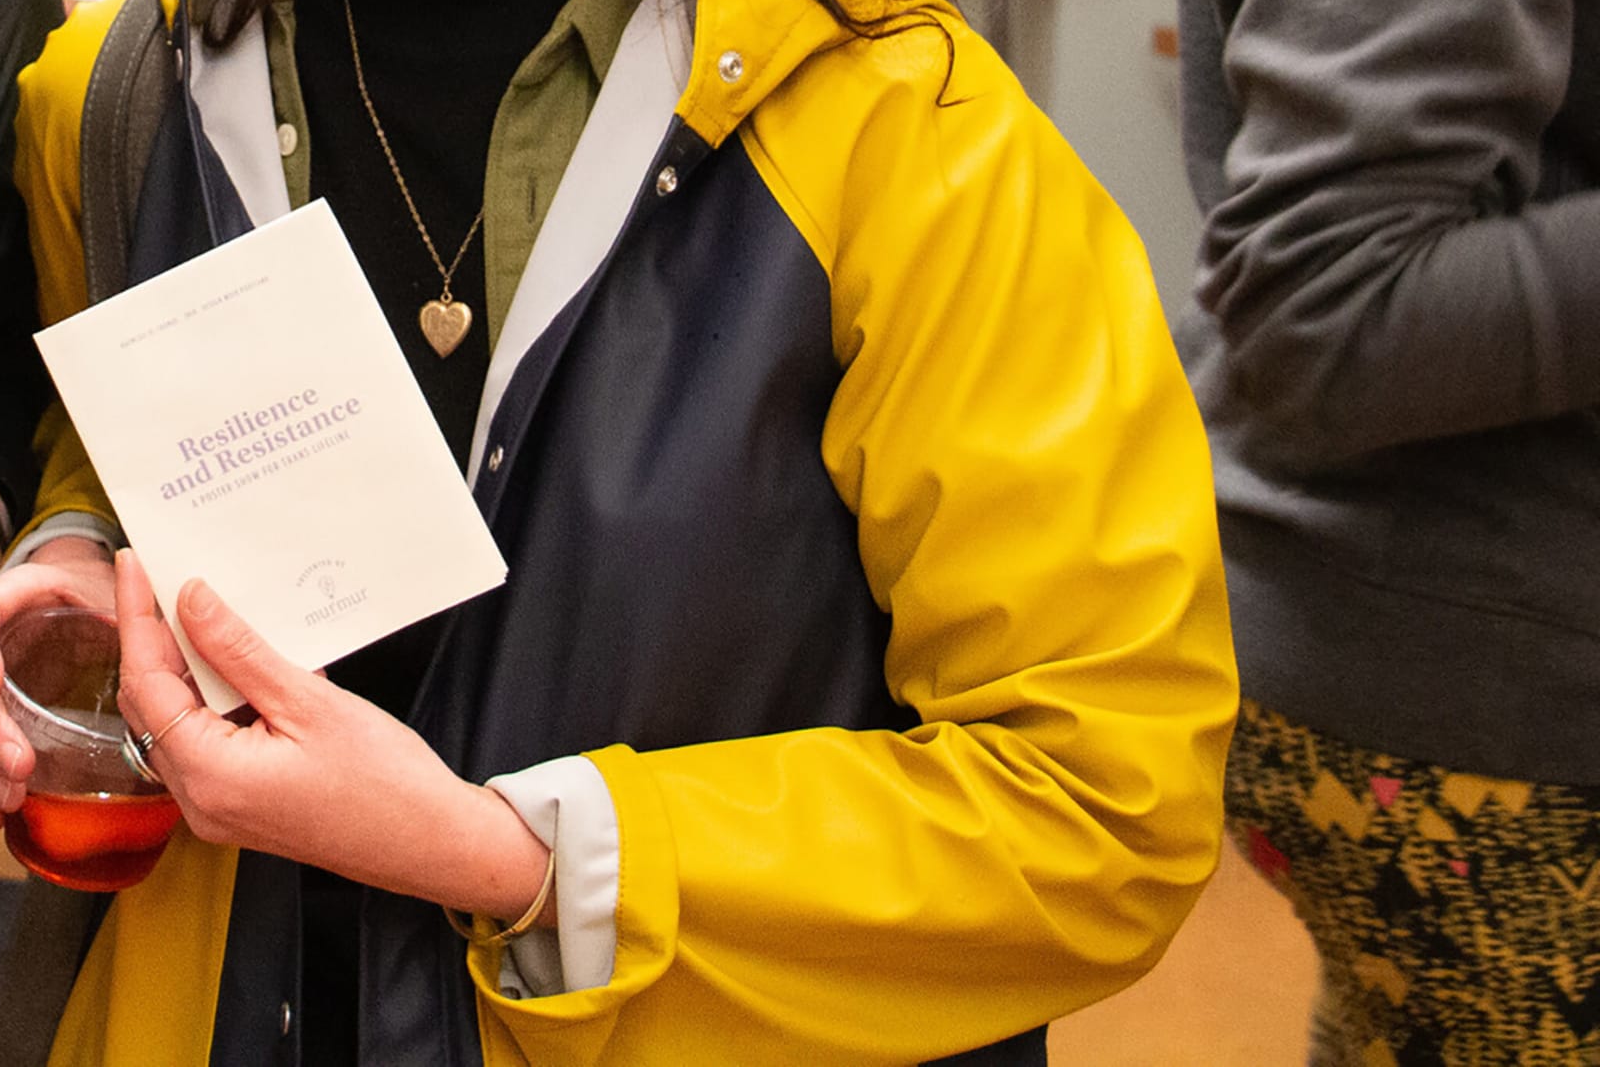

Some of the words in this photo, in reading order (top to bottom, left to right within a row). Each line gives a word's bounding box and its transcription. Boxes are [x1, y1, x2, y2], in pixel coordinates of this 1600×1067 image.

[160, 459, 213, 501] and
[214, 397, 361, 474] Resistance
[177, 388, 319, 462] Resilience
[191, 497, 199, 508] A
[200, 483, 232, 504] POSTER
[234, 471, 260, 489] SHOW
[261, 460, 280, 475] FOR
[281, 445, 310, 466] TRANS
[311, 429, 351, 454] LIFELINE
[304, 588, 368, 627] murmur
